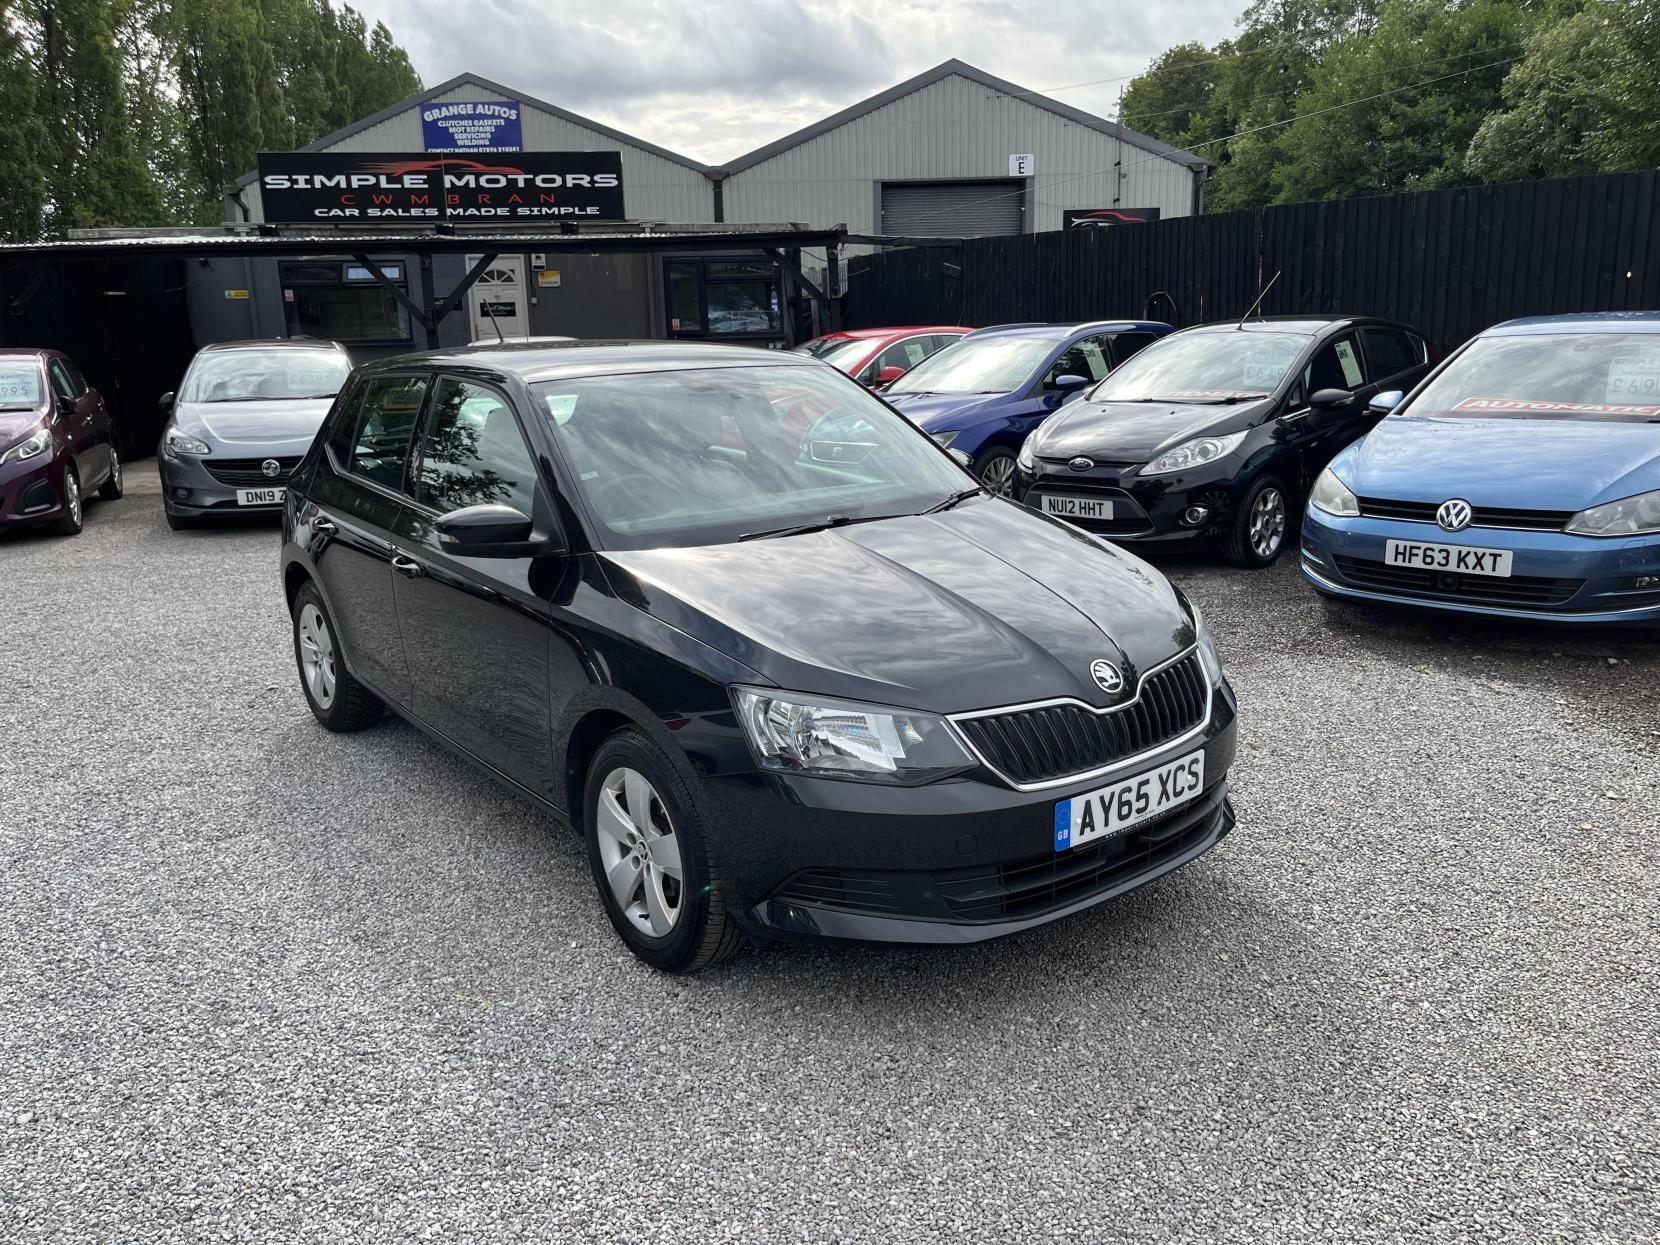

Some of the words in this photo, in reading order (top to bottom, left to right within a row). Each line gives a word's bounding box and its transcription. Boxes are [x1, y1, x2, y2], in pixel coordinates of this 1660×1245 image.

[424, 104, 474, 121] GRANGE
[475, 105, 518, 120] AUTOS
[1018, 162, 1025, 174] E
[264, 175, 429, 189] SIMPLE
[444, 174, 619, 188] MOTORS
[314, 208, 360, 217] CAR
[367, 208, 439, 217] SALES
[447, 207, 510, 216] MADE
[517, 206, 600, 215] SIMPLE
[1465, 400, 1653, 413] AUTOMATIC
[246, 490, 275, 503] DN19
[1048, 498, 1075, 514] NU12
[1079, 501, 1104, 516] HHT
[1394, 544, 1450, 567] HF63
[1456, 550, 1502, 572] KXT
[1079, 778, 1151, 836] AY65
[1157, 757, 1200, 806] XCS
[1057, 828, 1069, 841] GB
